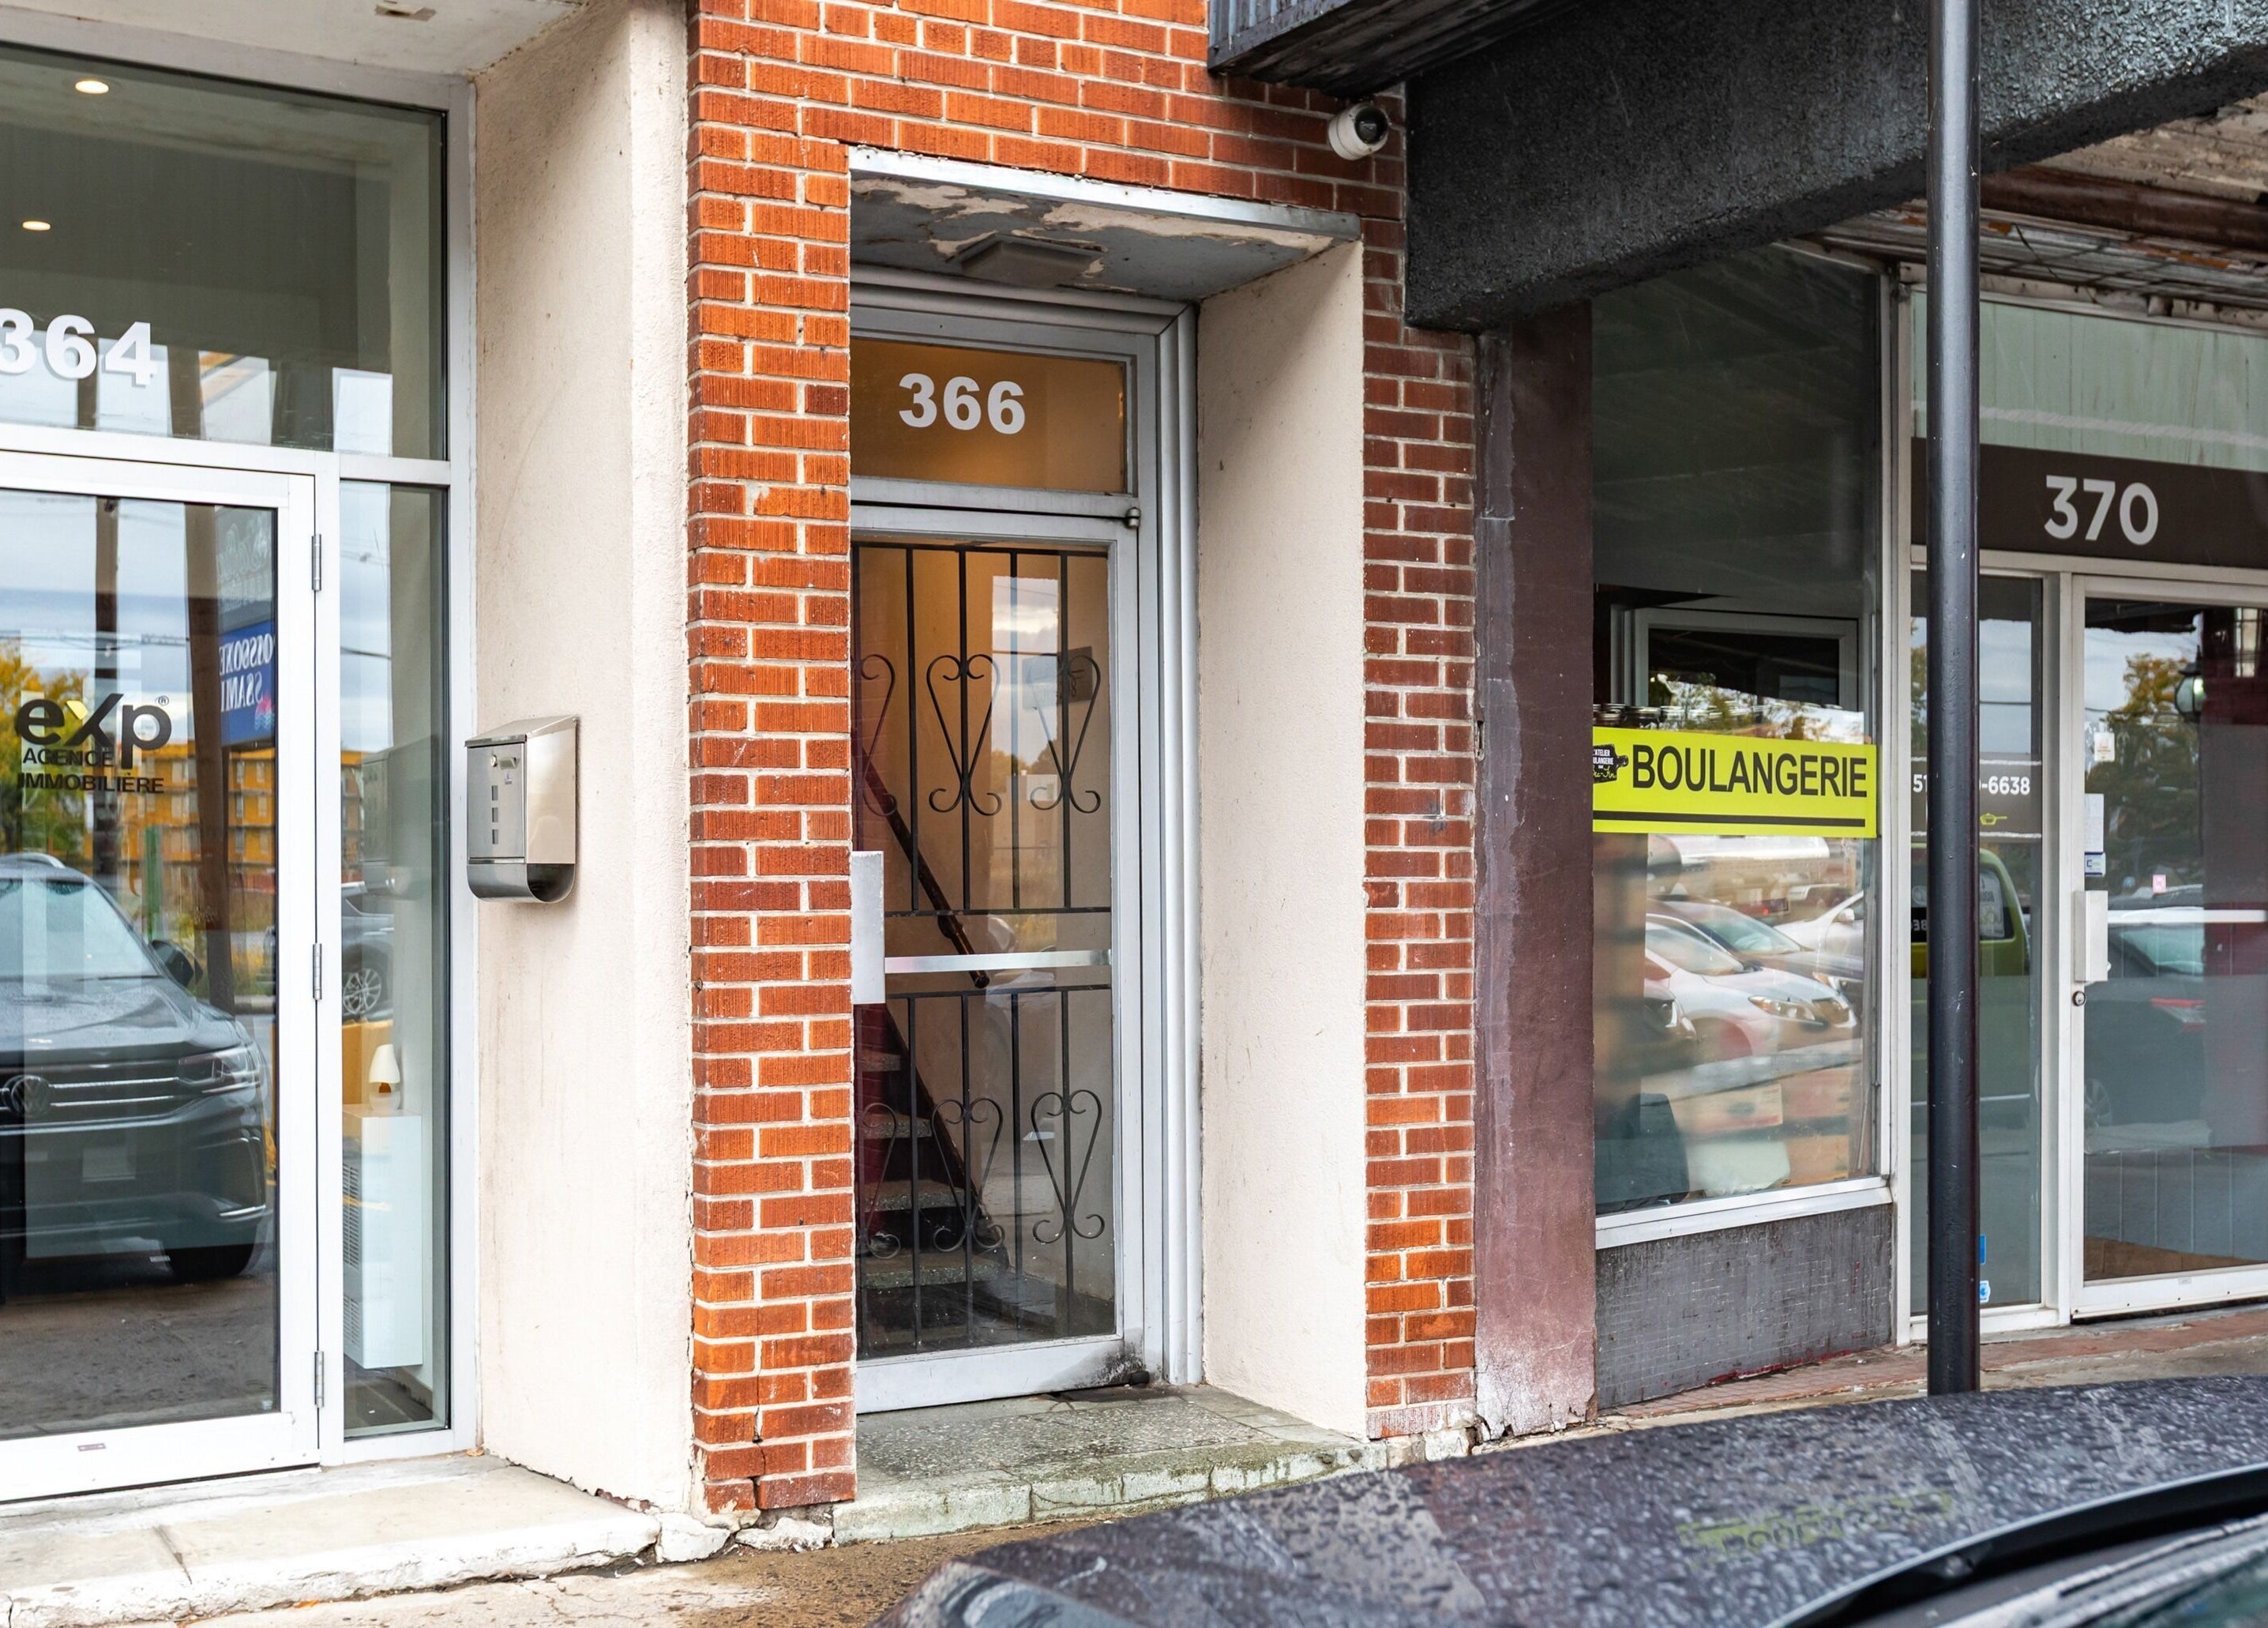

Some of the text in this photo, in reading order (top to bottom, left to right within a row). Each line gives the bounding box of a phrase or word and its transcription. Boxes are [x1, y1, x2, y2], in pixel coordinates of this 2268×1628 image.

[0, 308, 158, 386] 364
[899, 373, 1025, 434] 366
[2044, 475, 2159, 545] 370
[17, 772, 165, 794] IMMOBILIÈRE
[23, 747, 115, 767] AGENCE
[1632, 744, 1868, 798] BOULANGERIE
[1979, 776, 2030, 795] -6638
